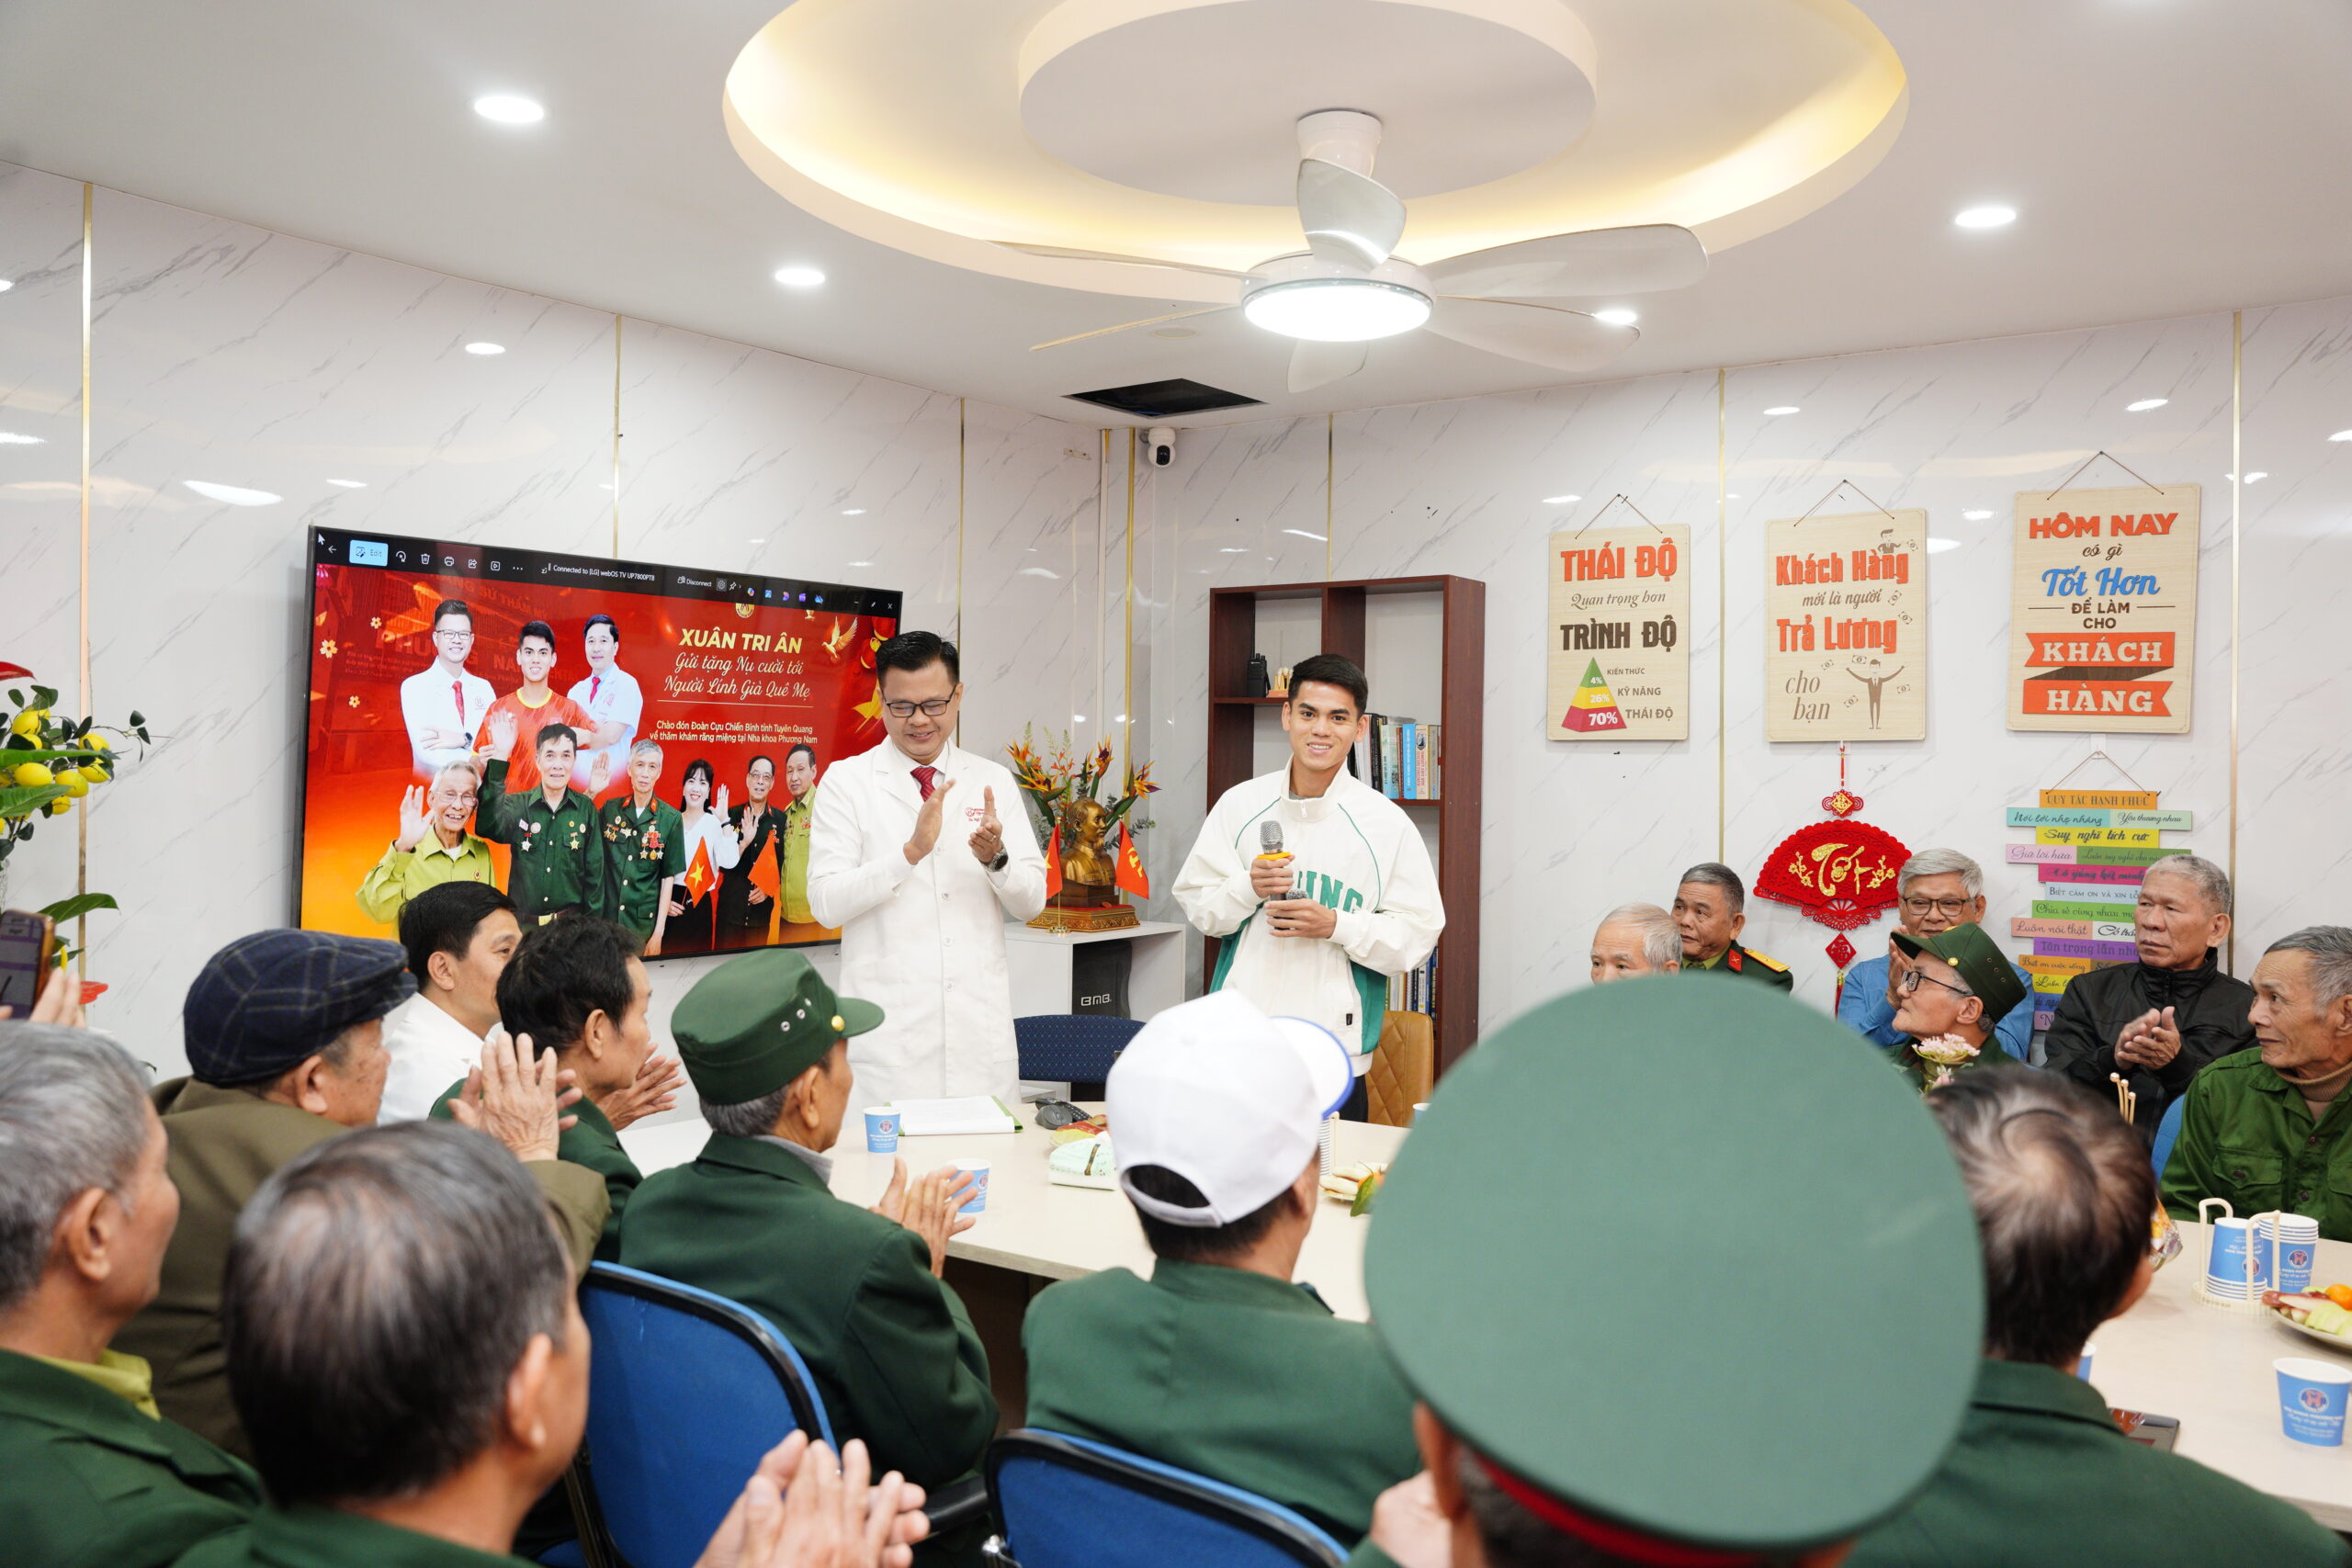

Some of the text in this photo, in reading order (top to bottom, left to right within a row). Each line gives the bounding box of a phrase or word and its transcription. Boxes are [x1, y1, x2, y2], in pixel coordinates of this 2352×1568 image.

[2030, 512, 2178, 539] HÔM NAY
[1560, 537, 1678, 581] THÁI ĐỘ
[2082, 543, 2123, 561] có gì
[553, 564, 582, 574] Connected
[600, 570, 618, 578] webOS
[1776, 548, 1909, 586] Khách Hàng
[686, 578, 712, 587] Disconnect
[2041, 565, 2161, 596] Tốt Hơn
[1571, 590, 1667, 610] Quan trọng hơn
[1802, 588, 1883, 609] mới là người
[2071, 597, 2130, 615] ĐỂ LÀM
[2083, 617, 2117, 629] CHO
[679, 626, 803, 654] XUÂN TRI ÂN
[1560, 615, 1677, 652] TRÌNH ĐỘ
[1776, 614, 1897, 654] Trả Lương
[2041, 636, 2163, 662] KHÁCH
[674, 651, 804, 676] Gửi tặng Nụ cười tới
[1606, 667, 1624, 675] KIẾN
[663, 675, 810, 701] Người Lính Già Quê Mẹ
[1590, 676, 1603, 684] 4%
[1785, 670, 1821, 694] cho
[1589, 694, 1611, 704] 26%
[1617, 685, 1662, 696] KỸ NĂNG
[2046, 682, 2154, 713] HÀNG
[1588, 711, 1619, 727] 70%
[1625, 706, 1674, 721] THÁI ĐỘ
[1792, 696, 1830, 724] bạn
[650, 730, 818, 744] về thăm khám răng miệng tại Nha khoa Phương Nam
[656, 720, 674, 729] Chào
[676, 721, 689, 730] đón
[691, 721, 708, 730] Đoàn
[710, 722, 724, 732] Cựu
[725, 722, 743, 731] Chiến
[745, 723, 759, 732] Binh
[774, 724, 791, 734] Tuyên
[793, 725, 813, 734] Quang
[2044, 829, 2071, 843] Suy
[1297, 870, 1363, 914] ING
[2036, 903, 2058, 915] Chia
